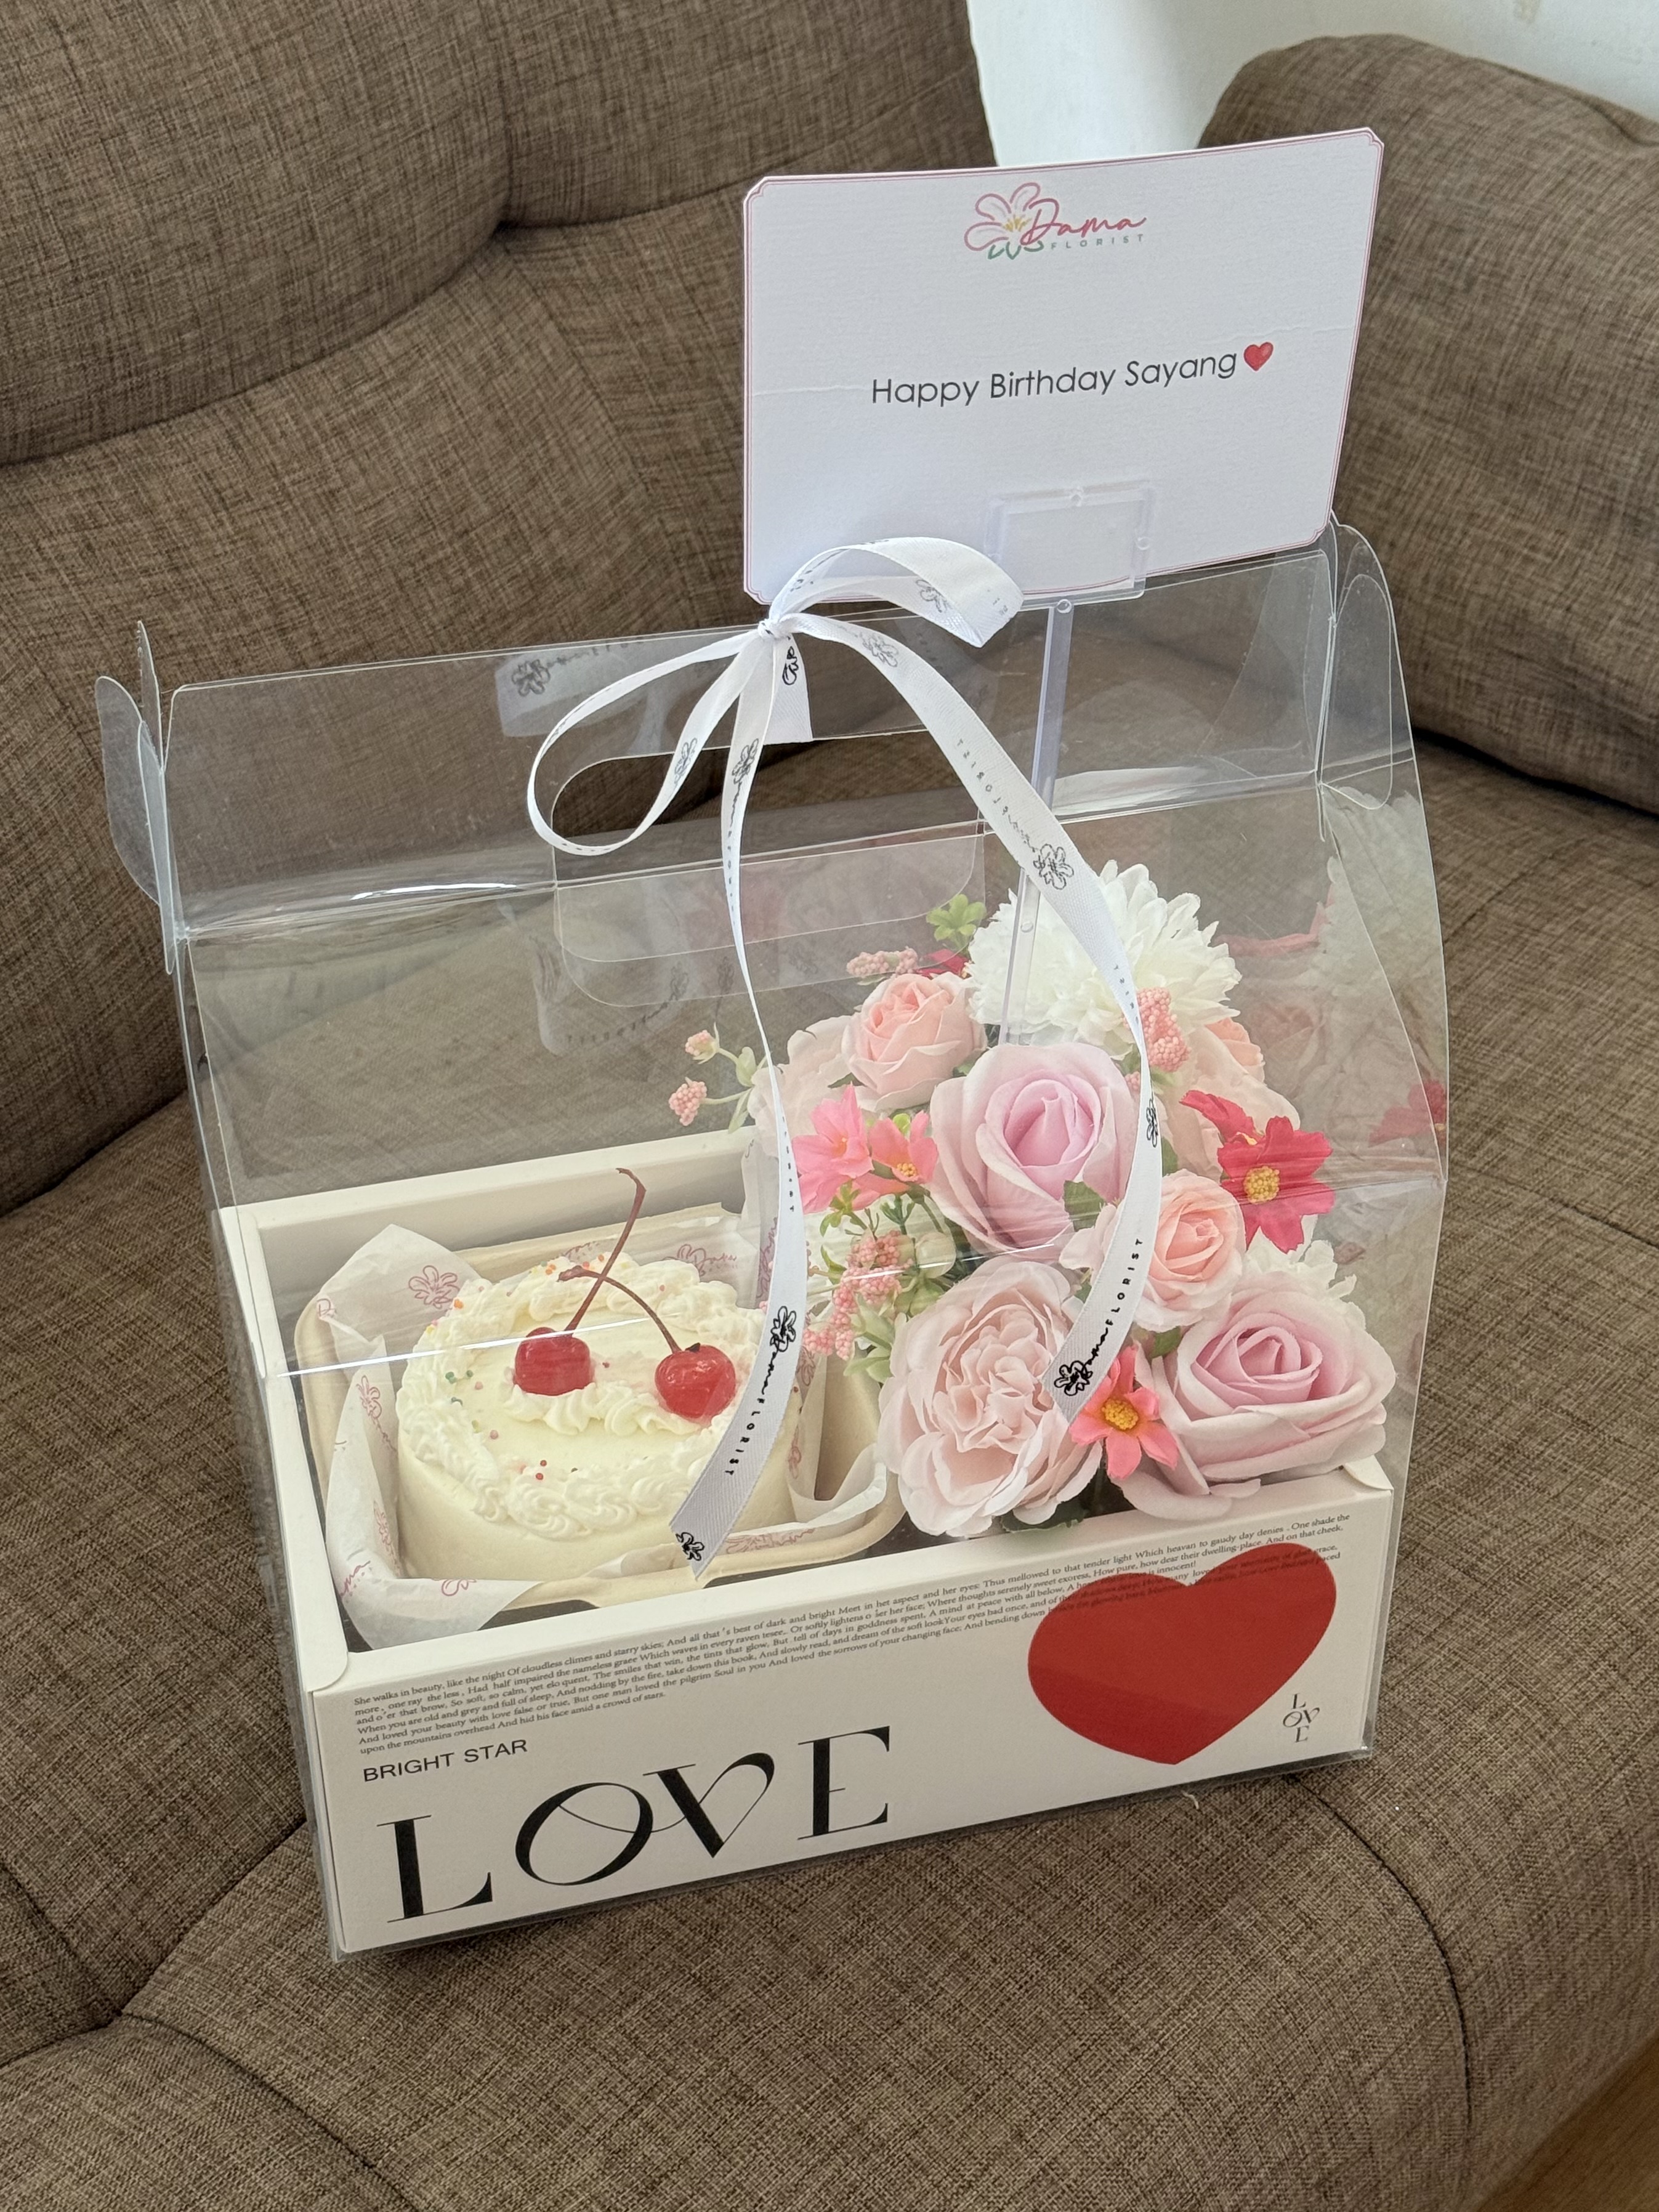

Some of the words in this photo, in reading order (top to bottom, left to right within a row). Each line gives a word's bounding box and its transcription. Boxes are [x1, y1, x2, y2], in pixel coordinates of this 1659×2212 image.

[1051, 233, 1144, 250] FLORIST
[871, 378, 980, 408] Happy
[990, 366, 1116, 398] Birthday
[1124, 352, 1237, 387] Sayang
[1105, 1238, 1143, 1326] FLORIST
[353, 1697, 371, 1706] She
[372, 1691, 399, 1702] walks
[446, 1679, 464, 1688] like
[464, 1676, 480, 1684] the
[482, 1671, 506, 1682] night
[521, 1661, 563, 1674] cloudless
[594, 1649, 612, 1660] and
[613, 1646, 639, 1657] starry
[666, 1636, 687, 1647] And
[689, 1633, 700, 1642] all
[702, 1631, 720, 1640] that
[733, 1625, 751, 1634] best
[765, 1618, 787, 1628] dark
[789, 1613, 806, 1624] and
[809, 1609, 836, 1620] bright
[838, 1605, 862, 1615] Meet
[922, 1588, 940, 1599] and
[942, 1587, 958, 1596] her
[982, 1578, 1006, 1588] Thus
[1007, 1568, 1050, 1584] mellowed
[1064, 1564, 1081, 1573] that
[1083, 1557, 1111, 1569] tender
[1113, 1553, 1132, 1565] light
[1135, 1547, 1164, 1559] Which
[1210, 1535, 1237, 1548] gaudy
[1238, 1532, 1255, 1540] day
[1256, 1527, 1284, 1536] denies
[1291, 1522, 1310, 1530] One
[1336, 1514, 1350, 1522] the
[356, 1714, 375, 1725] and
[398, 1708, 418, 1717] that
[530, 1684, 544, 1694] yet
[592, 1671, 612, 1680] The
[613, 1665, 642, 1676] smiles
[644, 1661, 661, 1671] that
[686, 1654, 701, 1663] the
[703, 1650, 723, 1659] tints
[725, 1645, 743, 1655] that
[773, 1637, 789, 1647] But
[793, 1633, 807, 1642] tell
[821, 1628, 842, 1637] days
[938, 1604, 963, 1615] mind
[977, 1599, 1002, 1610] peace
[1004, 1592, 1023, 1603] with
[1025, 1590, 1035, 1599] all
[357, 1724, 387, 1735] When
[388, 1721, 407, 1731] you
[408, 1718, 422, 1726] are
[423, 1712, 440, 1722] old
[440, 1708, 459, 1719] and
[460, 1706, 481, 1718] grey
[482, 1701, 500, 1711] and
[501, 1697, 517, 1708] full
[556, 1686, 577, 1698] And
[578, 1681, 617, 1693] nodding
[631, 1674, 645, 1683] the
[666, 1667, 685, 1677] take
[685, 1663, 712, 1673] down
[714, 1658, 730, 1668] this
[759, 1647, 779, 1659] And
[780, 1643, 808, 1655] slowly
[832, 1634, 850, 1645] and
[850, 1631, 879, 1642] dream
[891, 1626, 906, 1634] the
[906, 1621, 922, 1631] soft
[944, 1615, 966, 1625] Your
[967, 1611, 986, 1621] eyes
[1030, 1597, 1046, 1609] and
[358, 1734, 380, 1745] And
[382, 1728, 408, 1741] loved
[410, 1726, 432, 1737] your
[435, 1719, 466, 1730] beauty
[469, 1714, 490, 1724] with
[491, 1711, 511, 1720] love
[514, 1706, 534, 1716] false
[573, 1695, 589, 1704] But
[591, 1692, 610, 1700] one
[612, 1688, 632, 1697] man
[634, 1680, 660, 1692] loved
[663, 1679, 677, 1687] the
[679, 1673, 712, 1686] pilgrim
[714, 1666, 734, 1677] Soul
[748, 1663, 766, 1673] you
[768, 1656, 788, 1667] And
[791, 1651, 815, 1663] loved
[817, 1649, 832, 1658] the
[879, 1637, 900, 1648] your
[901, 1629, 942, 1642] changing
[964, 1620, 983, 1631] And
[985, 1615, 1020, 1626] bending
[1020, 1610, 1046, 1620] down
[387, 1701, 406, 1709] one
[407, 1698, 422, 1706] ray
[427, 1693, 442, 1702] the
[467, 1683, 489, 1695] Had
[493, 1679, 511, 1690] half
[514, 1670, 555, 1686] impaired
[556, 1669, 571, 1677] the
[572, 1661, 613, 1675] nameless
[639, 1649, 670, 1661] Which
[671, 1645, 698, 1655] waves
[710, 1639, 735, 1649] every
[804, 1620, 829, 1631] softly
[830, 1615, 864, 1628] lightens
[889, 1607, 904, 1616] her
[927, 1597, 957, 1607] Where
[958, 1590, 996, 1602] thoughts
[1093, 1567, 1115, 1577] How
[1139, 1559, 1159, 1568] how
[1181, 1551, 1200, 1560] their
[1265, 1533, 1285, 1544] And
[1299, 1530, 1316, 1538] that
[360, 1745, 385, 1755] upon
[387, 1741, 402, 1750] the
[403, 1732, 452, 1746] mountains
[453, 1722, 496, 1737] overhead
[497, 1718, 518, 1729] And
[519, 1714, 535, 1725] hid
[536, 1713, 550, 1721] his
[551, 1710, 570, 1718] face
[571, 1703, 594, 1714] amid
[602, 1696, 631, 1709] crowd
[362, 1752, 456, 1782] BRIGHT
[463, 1738, 528, 1765] STAR
[377, 1726, 890, 1923] LOVE
